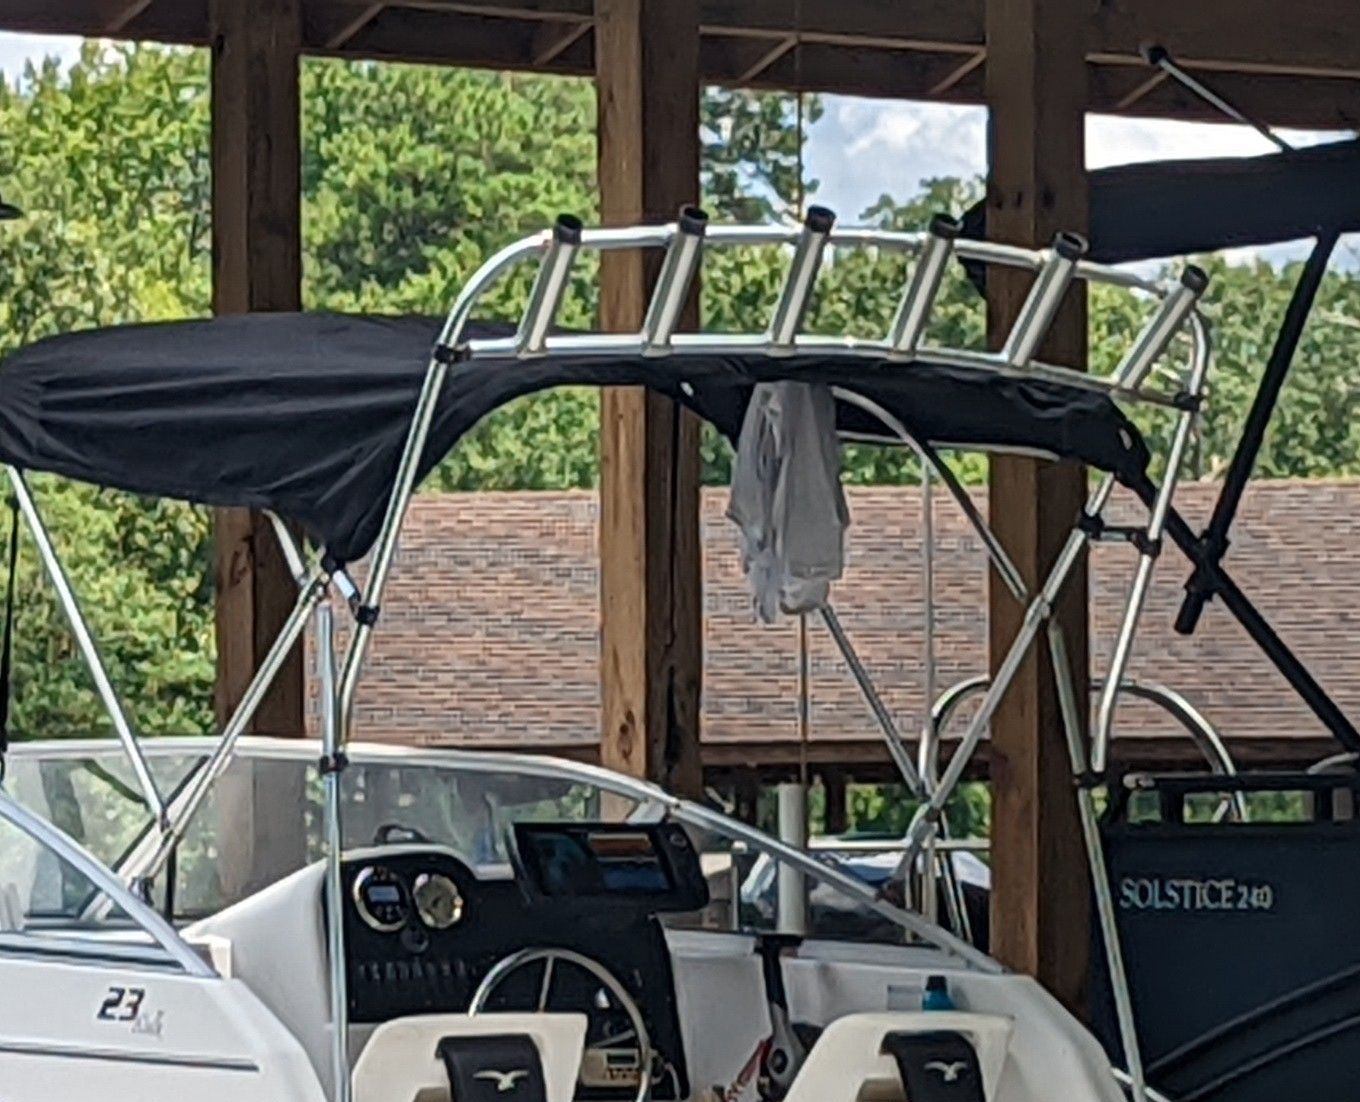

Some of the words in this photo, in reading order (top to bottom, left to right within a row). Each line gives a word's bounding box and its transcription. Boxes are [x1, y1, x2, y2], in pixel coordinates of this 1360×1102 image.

[1119, 878, 1235, 909] SOLSTICE
[1237, 884, 1274, 909] 240
[97, 986, 145, 1021] 23
